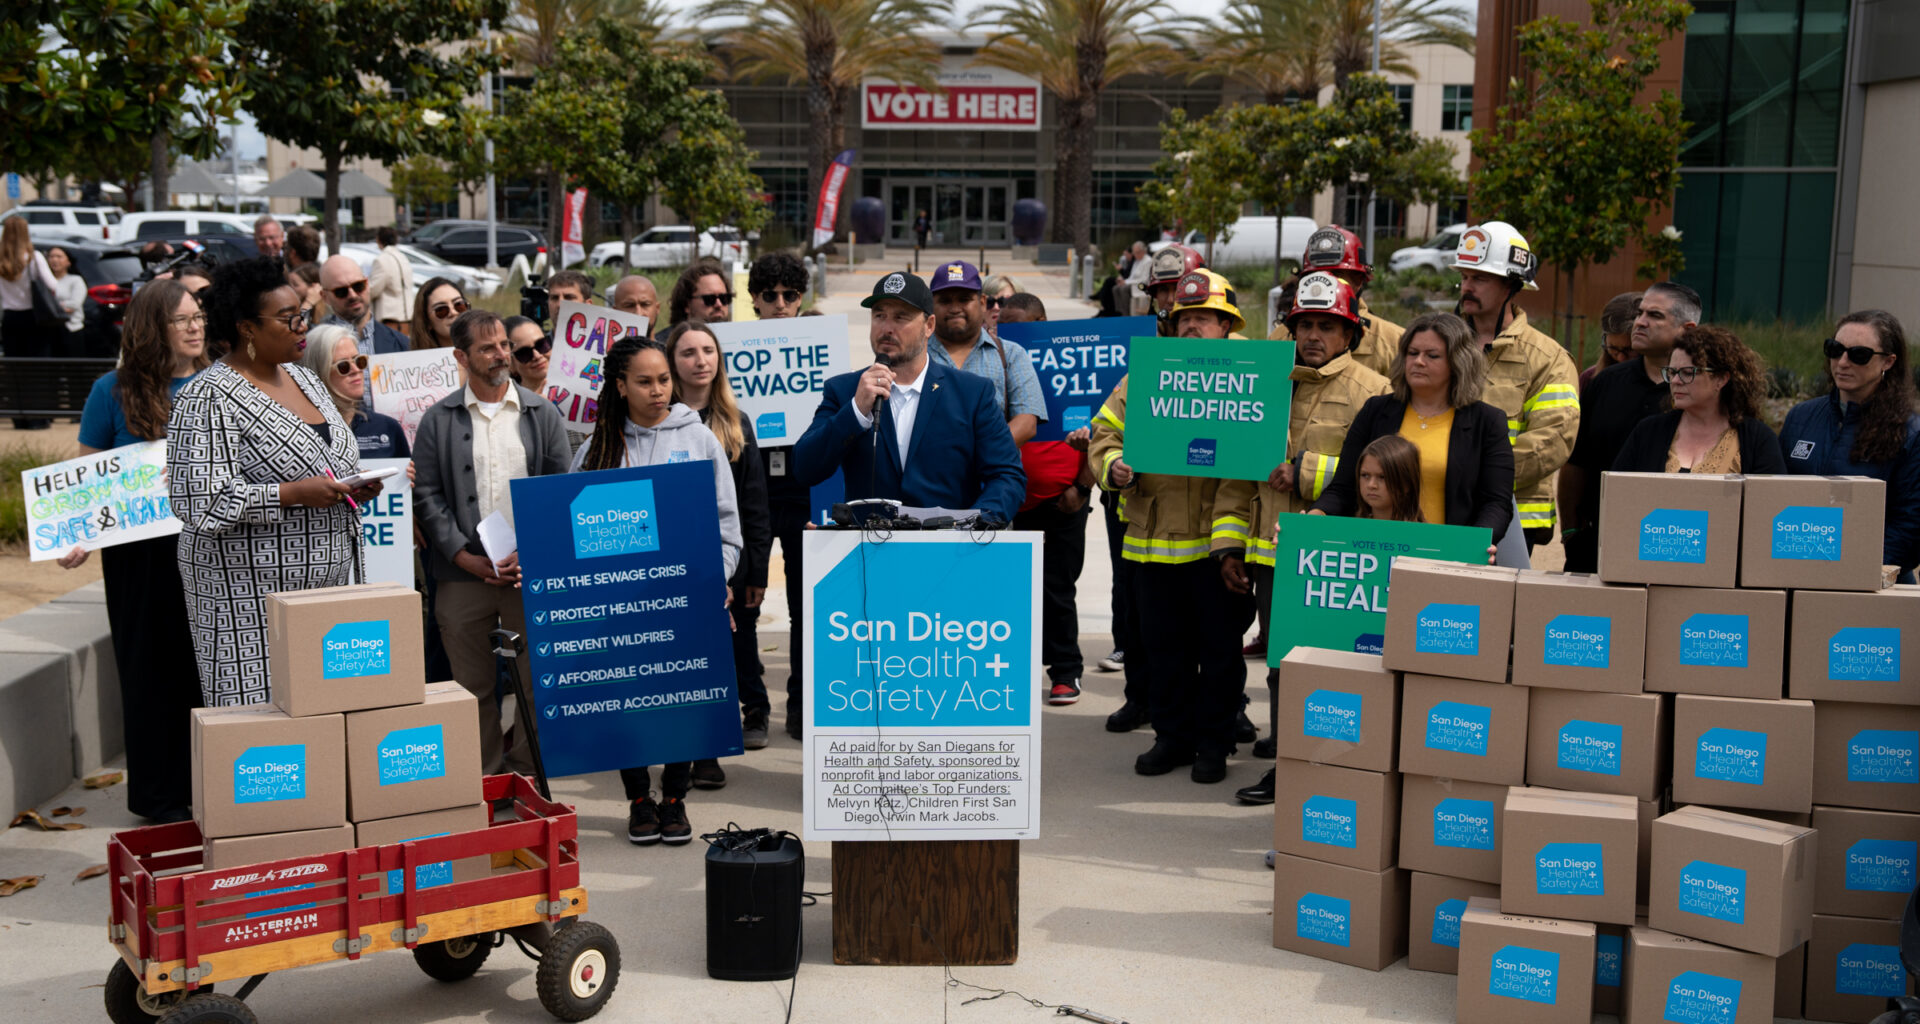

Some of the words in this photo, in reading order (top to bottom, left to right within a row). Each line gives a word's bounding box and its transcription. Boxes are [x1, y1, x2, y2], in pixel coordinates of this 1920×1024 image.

[869, 93, 949, 118] VOTE
[957, 94, 1035, 119] HERE
[1513, 248, 1528, 264] B5
[1304, 277, 1333, 287] CAPTAIN
[722, 349, 772, 373] TOP
[780, 345, 829, 369] THE
[1027, 345, 1126, 371] FASTER
[1187, 357, 1206, 366] VOTE
[1208, 358, 1220, 366] YES
[378, 356, 457, 394] Invest
[580, 358, 603, 390] 4
[1159, 370, 1259, 394] PREVENT
[729, 370, 824, 398] EWAGE
[1051, 372, 1102, 396] 911
[547, 386, 598, 423] KID
[1150, 396, 1264, 423] WILDFIRES
[34, 465, 87, 496] HELP
[95, 456, 120, 477] US
[31, 478, 113, 520] GROW
[121, 464, 160, 491] UP
[577, 511, 604, 526] San
[607, 508, 648, 523] Diego
[35, 511, 97, 551] SAFE
[97, 506, 116, 531] &
[589, 523, 637, 538] Health
[1644, 524, 1666, 534] San
[1668, 525, 1701, 537] Diego
[579, 536, 626, 553] Safety
[629, 534, 653, 547] Act
[1352, 540, 1376, 550] VOTE
[1379, 542, 1394, 551] YES
[1397, 543, 1410, 553] TO
[1297, 548, 1378, 580] KEEP
[547, 578, 566, 590] FIX
[568, 575, 591, 587] THE
[594, 569, 646, 584] SEWAGE
[649, 564, 687, 578] CRISIS
[1304, 580, 1390, 613] HEAL
[550, 605, 607, 622] PROTECT
[610, 596, 688, 616] HEALTHCARE
[828, 611, 895, 642] San
[908, 611, 1011, 650] Diego
[1420, 618, 1440, 628] San
[1443, 618, 1473, 631] Diego
[326, 640, 348, 650] San
[351, 638, 384, 650] Diego
[554, 637, 608, 654] PREVENT
[612, 629, 674, 647] WILDFIRES
[1684, 629, 1706, 639] San
[1708, 630, 1742, 642] Diego
[336, 649, 374, 660] Health
[1369, 644, 1384, 652] Dieg
[1833, 643, 1856, 653] San
[1858, 644, 1893, 656] Diego
[327, 661, 364, 673] Safety
[367, 658, 386, 668] Act
[857, 647, 976, 678] Health
[557, 665, 637, 686] AFFORDABLE
[639, 657, 708, 676] CHILDCARE
[561, 700, 621, 717] TAXPAYER
[623, 687, 728, 710] ACCOUNTABILITY
[828, 680, 947, 720] Safety
[954, 680, 1014, 711] Act
[1307, 702, 1326, 713] San
[1328, 705, 1356, 718] Diego
[382, 748, 403, 758] San
[406, 743, 437, 755] Diego
[829, 742, 846, 752] Ad
[850, 742, 876, 755] paid
[878, 742, 895, 752] for
[899, 741, 913, 754] by
[917, 742, 941, 752] San
[945, 741, 995, 754] Diegans
[998, 741, 1014, 751] for
[1701, 742, 1723, 753] San
[1725, 745, 1759, 758] Diego
[1852, 745, 1876, 755] San
[1878, 746, 1912, 758] Diego
[238, 765, 262, 775] San
[264, 763, 298, 774] Diego
[824, 755, 863, 766] Health
[867, 756, 889, 766] and
[894, 755, 935, 769] Safety,
[938, 755, 1002, 769] sponsored
[1006, 755, 1020, 767] by
[821, 770, 875, 783] nonprofit
[878, 770, 900, 780] and
[904, 770, 935, 780] labor
[938, 769, 1022, 783] organizations.
[833, 784, 849, 794] Ad
[853, 784, 928, 794] Committee's
[932, 784, 954, 797] Top
[958, 783, 1011, 794] Funders:
[827, 798, 870, 811] Melvyn
[874, 798, 905, 810] Katz,
[908, 797, 959, 808] Children
[963, 797, 989, 807] First
[992, 797, 1016, 807] San
[844, 812, 883, 824] Diego,
[887, 812, 915, 822] Irwin
[919, 812, 949, 821] Mark
[953, 811, 999, 822] Jacobs.
[1539, 859, 1561, 868] San
[1563, 859, 1596, 870] Diego
[1548, 868, 1587, 878] Health
[210, 873, 260, 890] RADIO
[279, 864, 326, 879] FLYER
[430, 870, 448, 880] Act
[1541, 878, 1577, 889] Safety
[1580, 879, 1599, 889] Act
[1683, 874, 1705, 886] San
[1707, 879, 1739, 895] Diego
[1300, 905, 1317, 916] San
[1319, 909, 1345, 922] Diego
[1438, 911, 1458, 922] San
[225, 931, 267, 942] CARGO
[275, 922, 318, 934] WAGON
[227, 914, 317, 936] ALL-TERRAIN
[1841, 958, 1863, 969] San
[1866, 960, 1900, 972] Diego
[1673, 984, 1695, 997] San
[1698, 988, 1731, 1005] Diego
